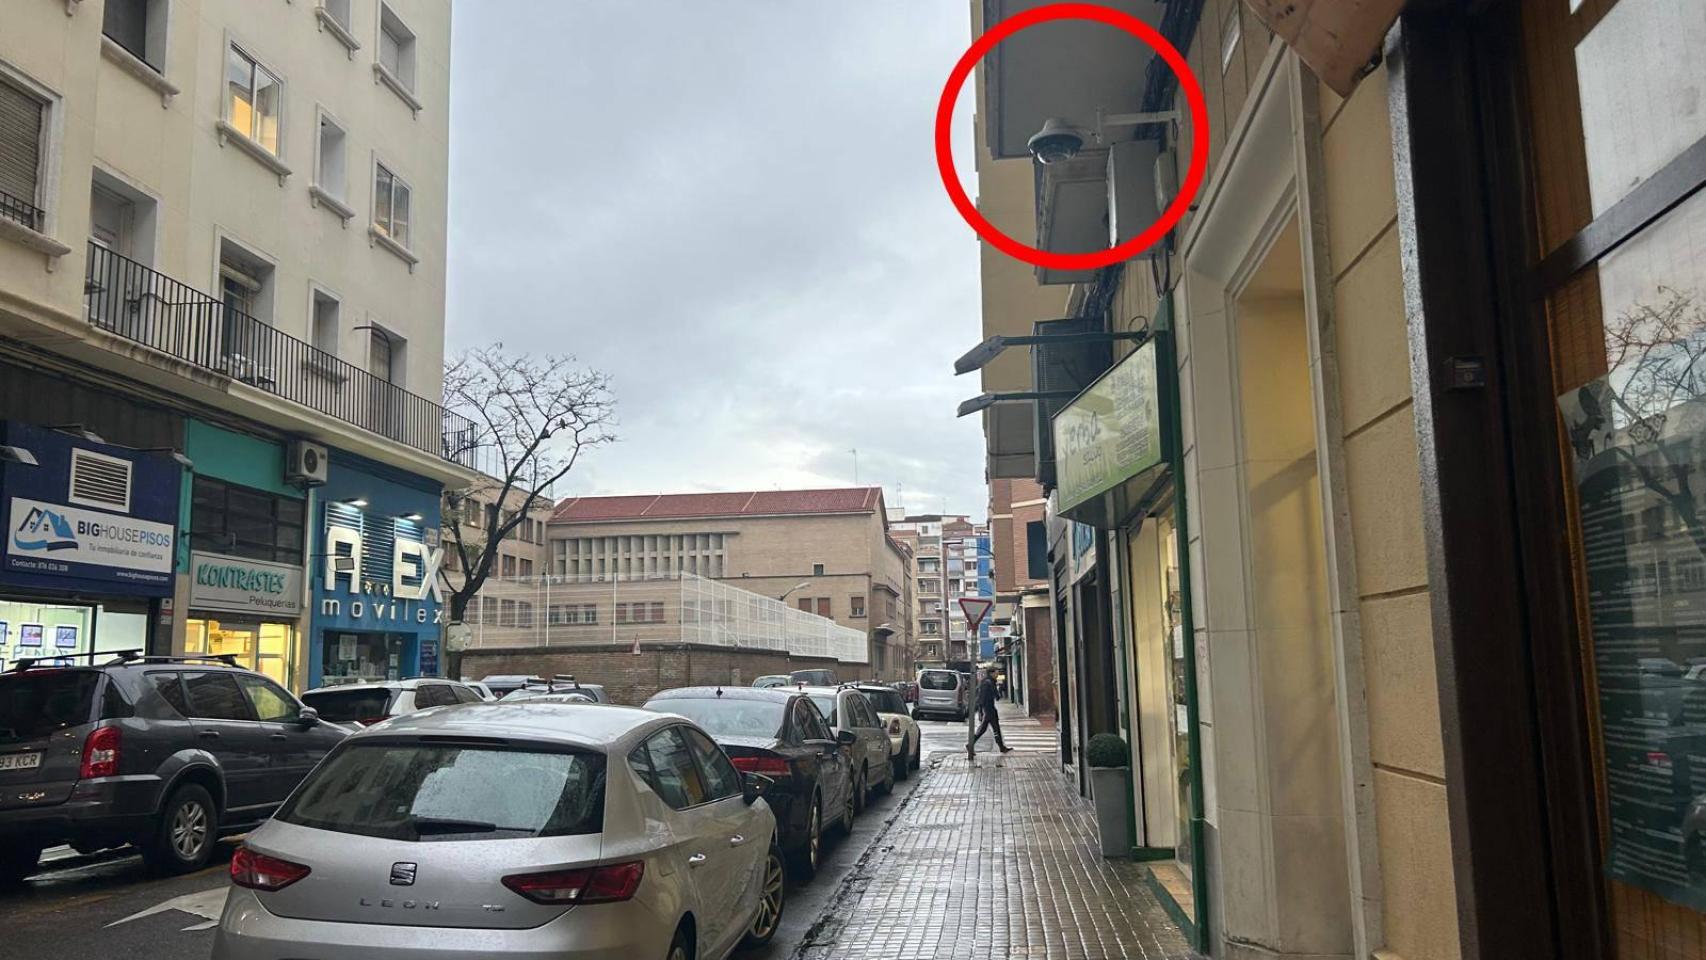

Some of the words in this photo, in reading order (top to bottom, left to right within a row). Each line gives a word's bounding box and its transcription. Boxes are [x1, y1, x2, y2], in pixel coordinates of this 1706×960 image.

[197, 563, 286, 595] KONTRASTES
[321, 599, 443, 624] movilex
[359, 898, 440, 911] LEON
